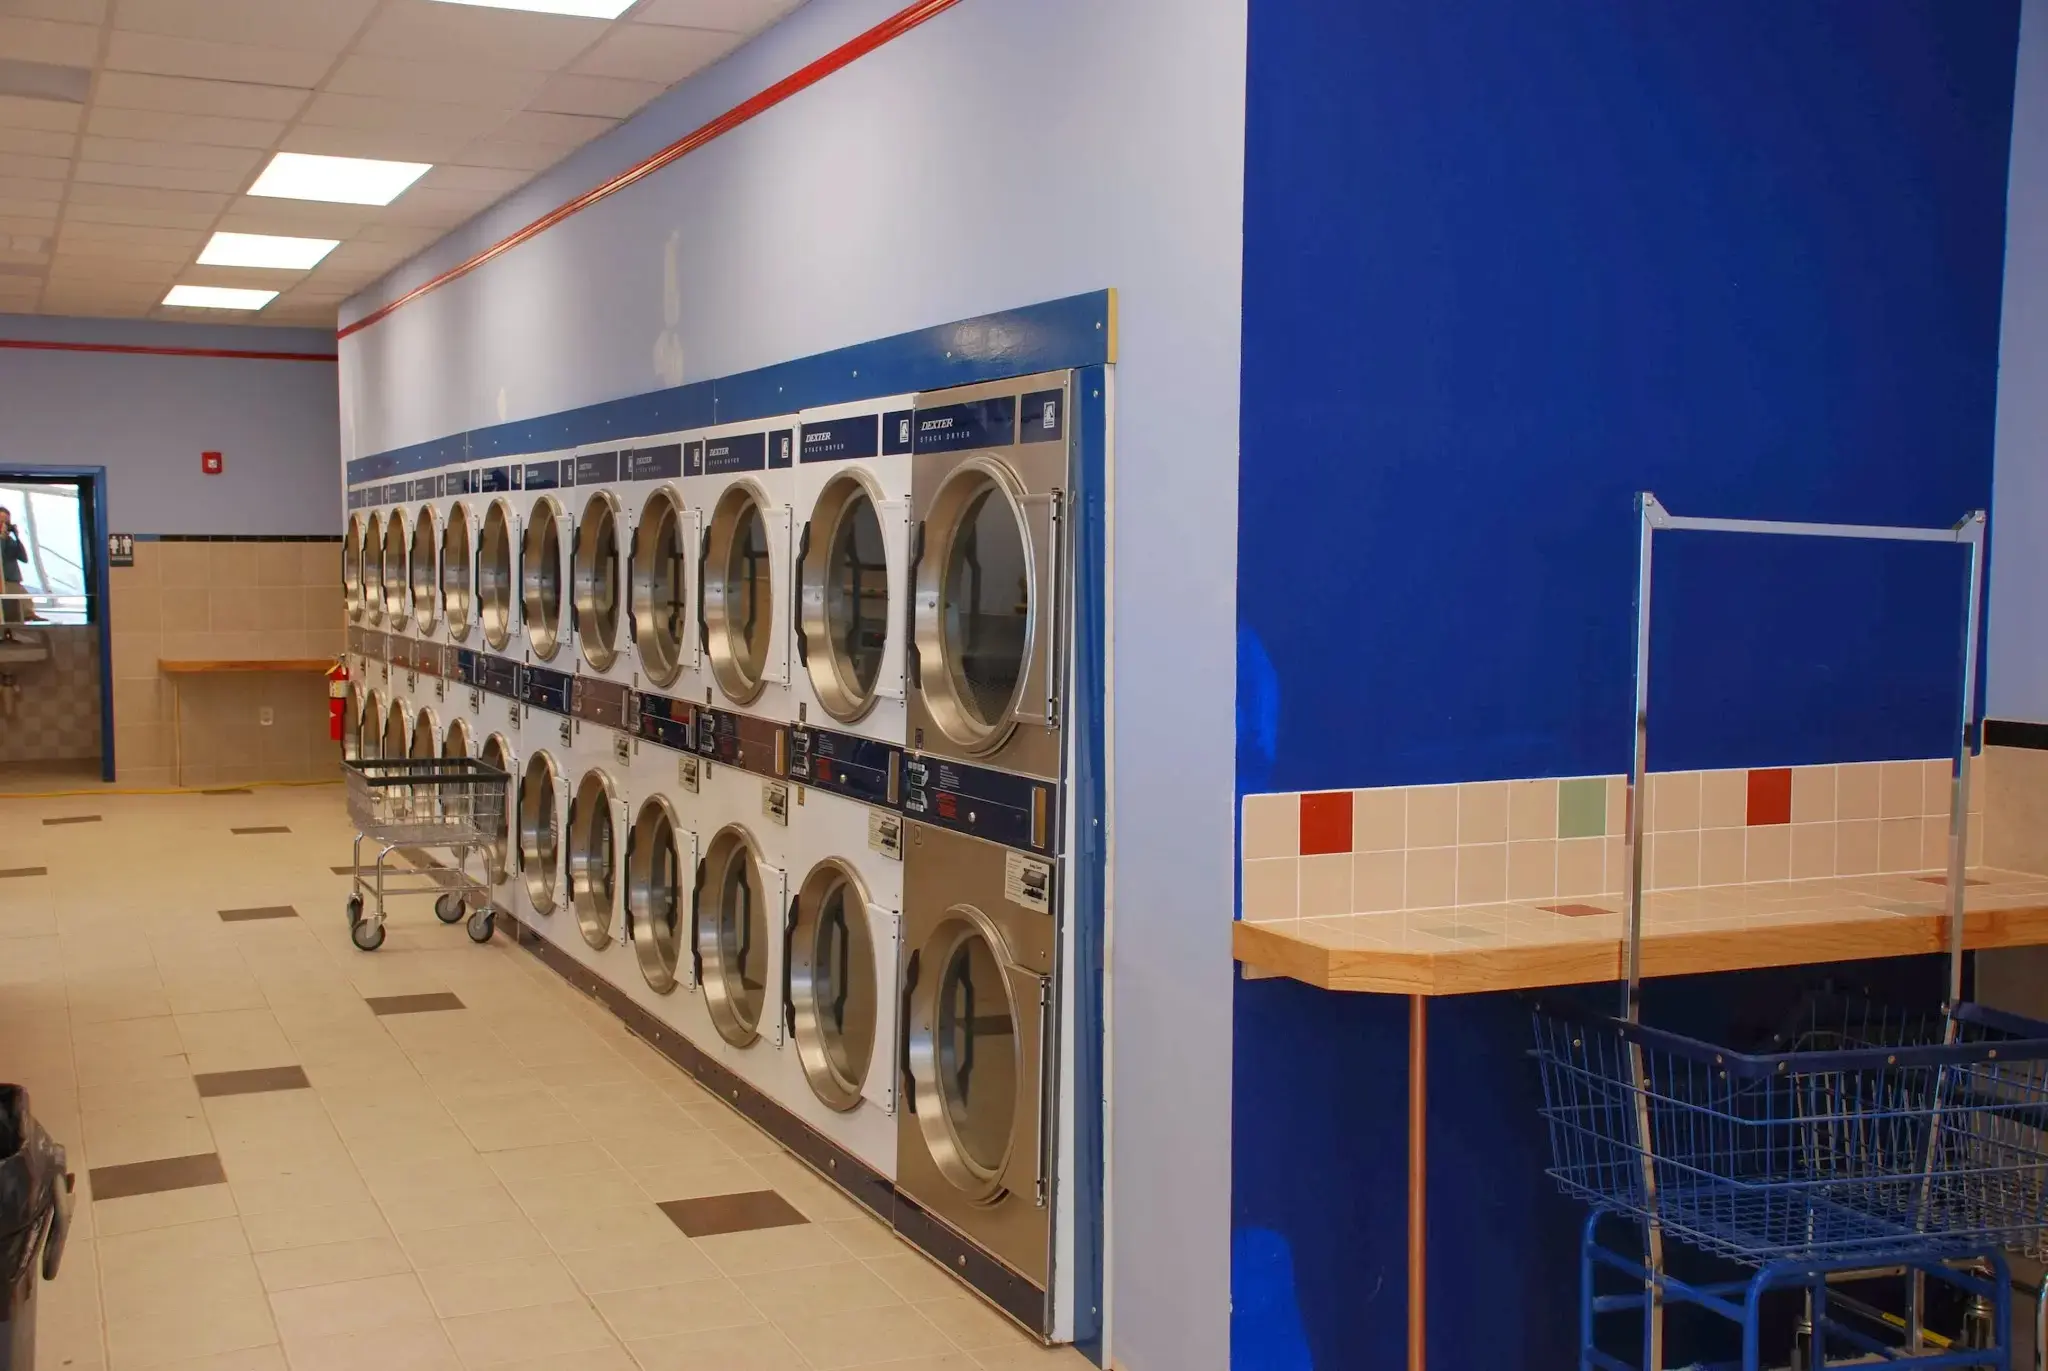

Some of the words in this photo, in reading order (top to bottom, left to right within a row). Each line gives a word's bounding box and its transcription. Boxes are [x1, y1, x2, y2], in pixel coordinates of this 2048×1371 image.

[921, 418, 953, 431] DEXTER
[805, 431, 831, 443] DEXTER
[920, 435, 942, 443] STACK
[946, 431, 970, 440] DRYER
